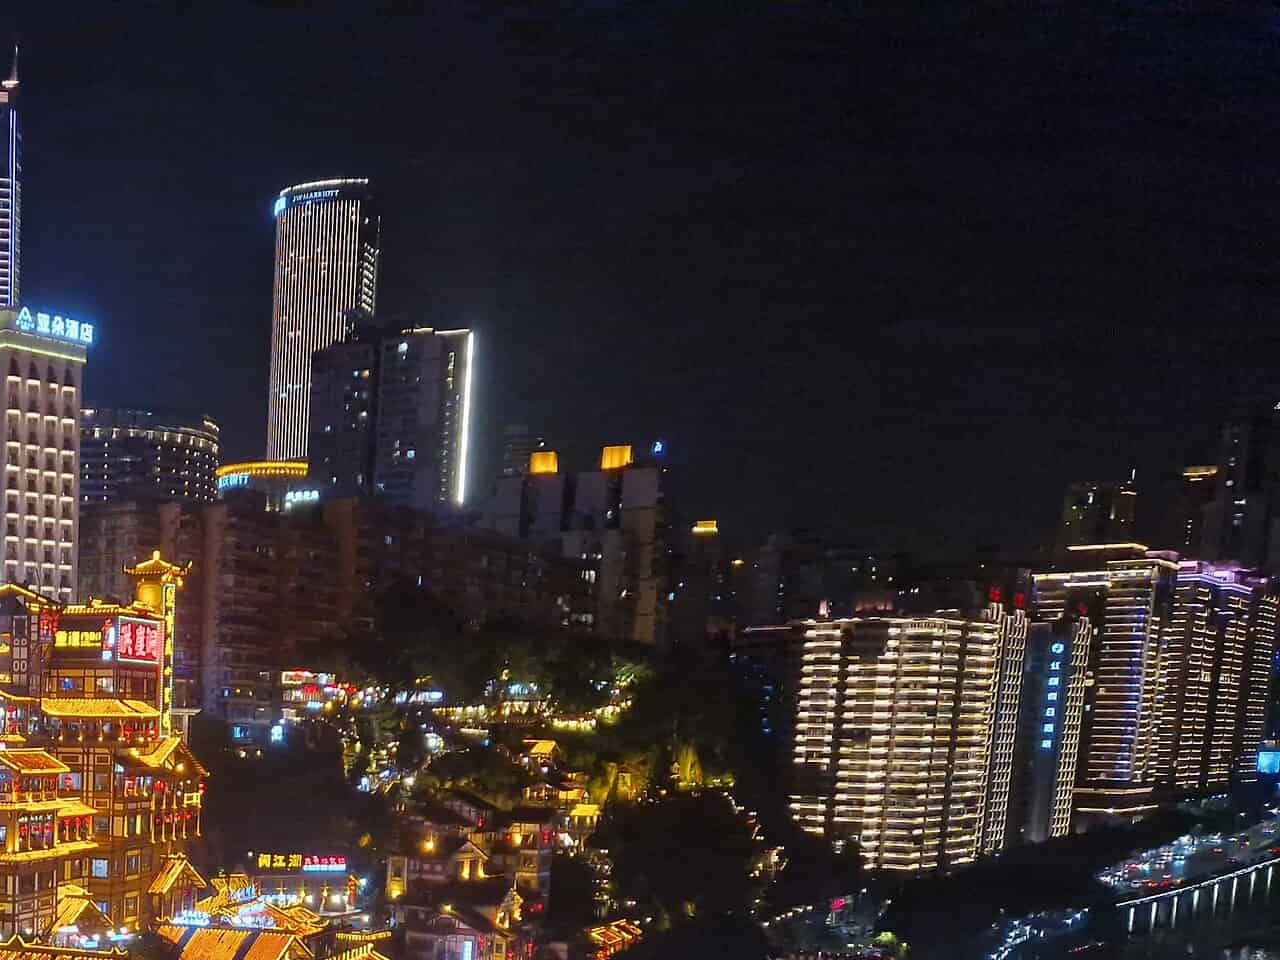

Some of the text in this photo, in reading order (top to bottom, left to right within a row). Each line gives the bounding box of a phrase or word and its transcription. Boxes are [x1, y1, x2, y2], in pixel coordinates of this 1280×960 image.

[303, 189, 339, 201] MARRIOTT
[36, 312, 94, 343] 亚朵酒店
